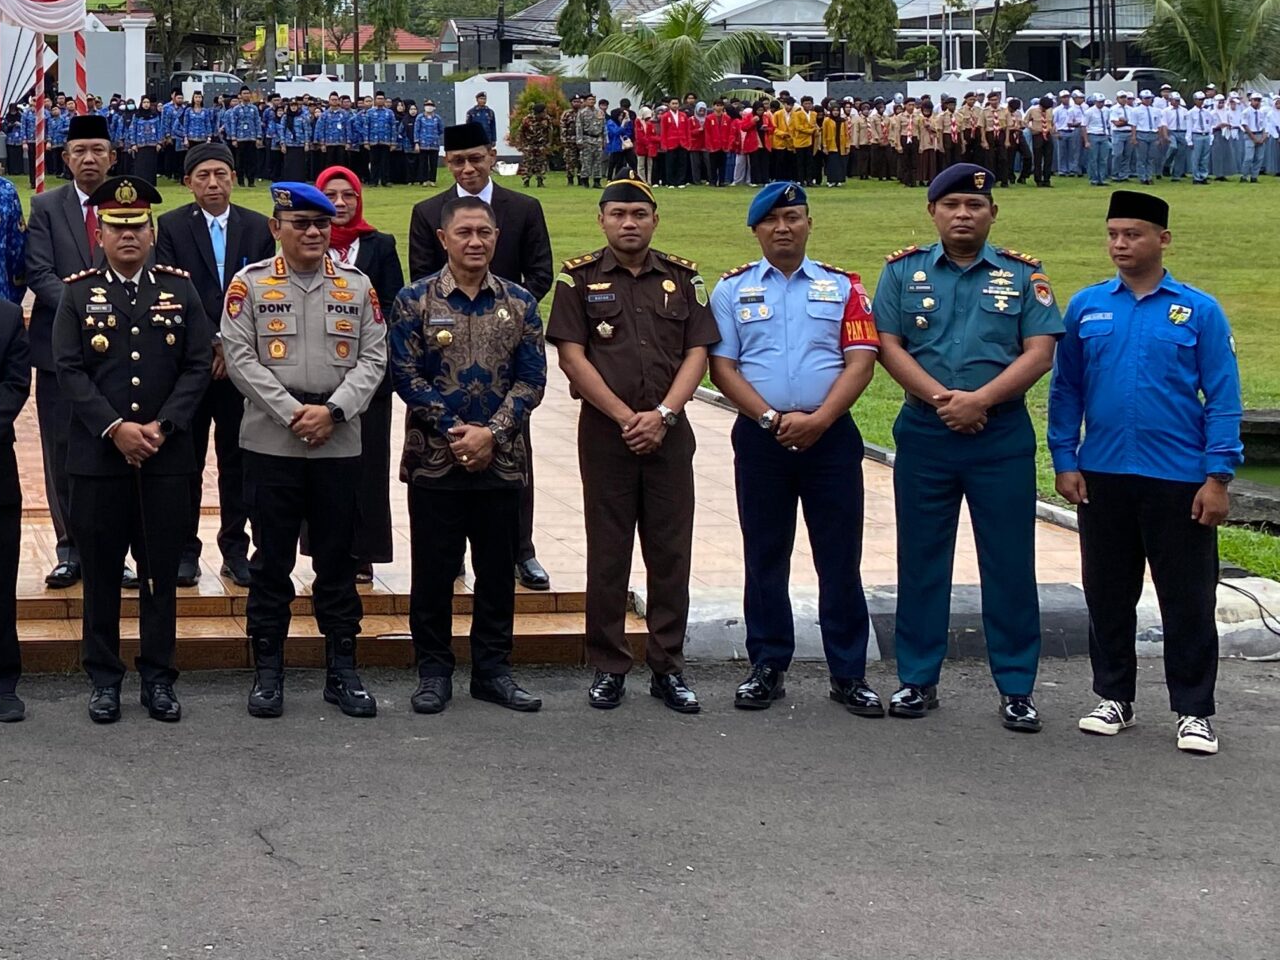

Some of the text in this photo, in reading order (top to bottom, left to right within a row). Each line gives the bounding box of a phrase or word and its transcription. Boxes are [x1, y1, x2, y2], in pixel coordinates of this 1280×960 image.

[258, 304, 292, 313] DONY
[327, 304, 359, 315] POLRI
[845, 320, 864, 341] PAM
